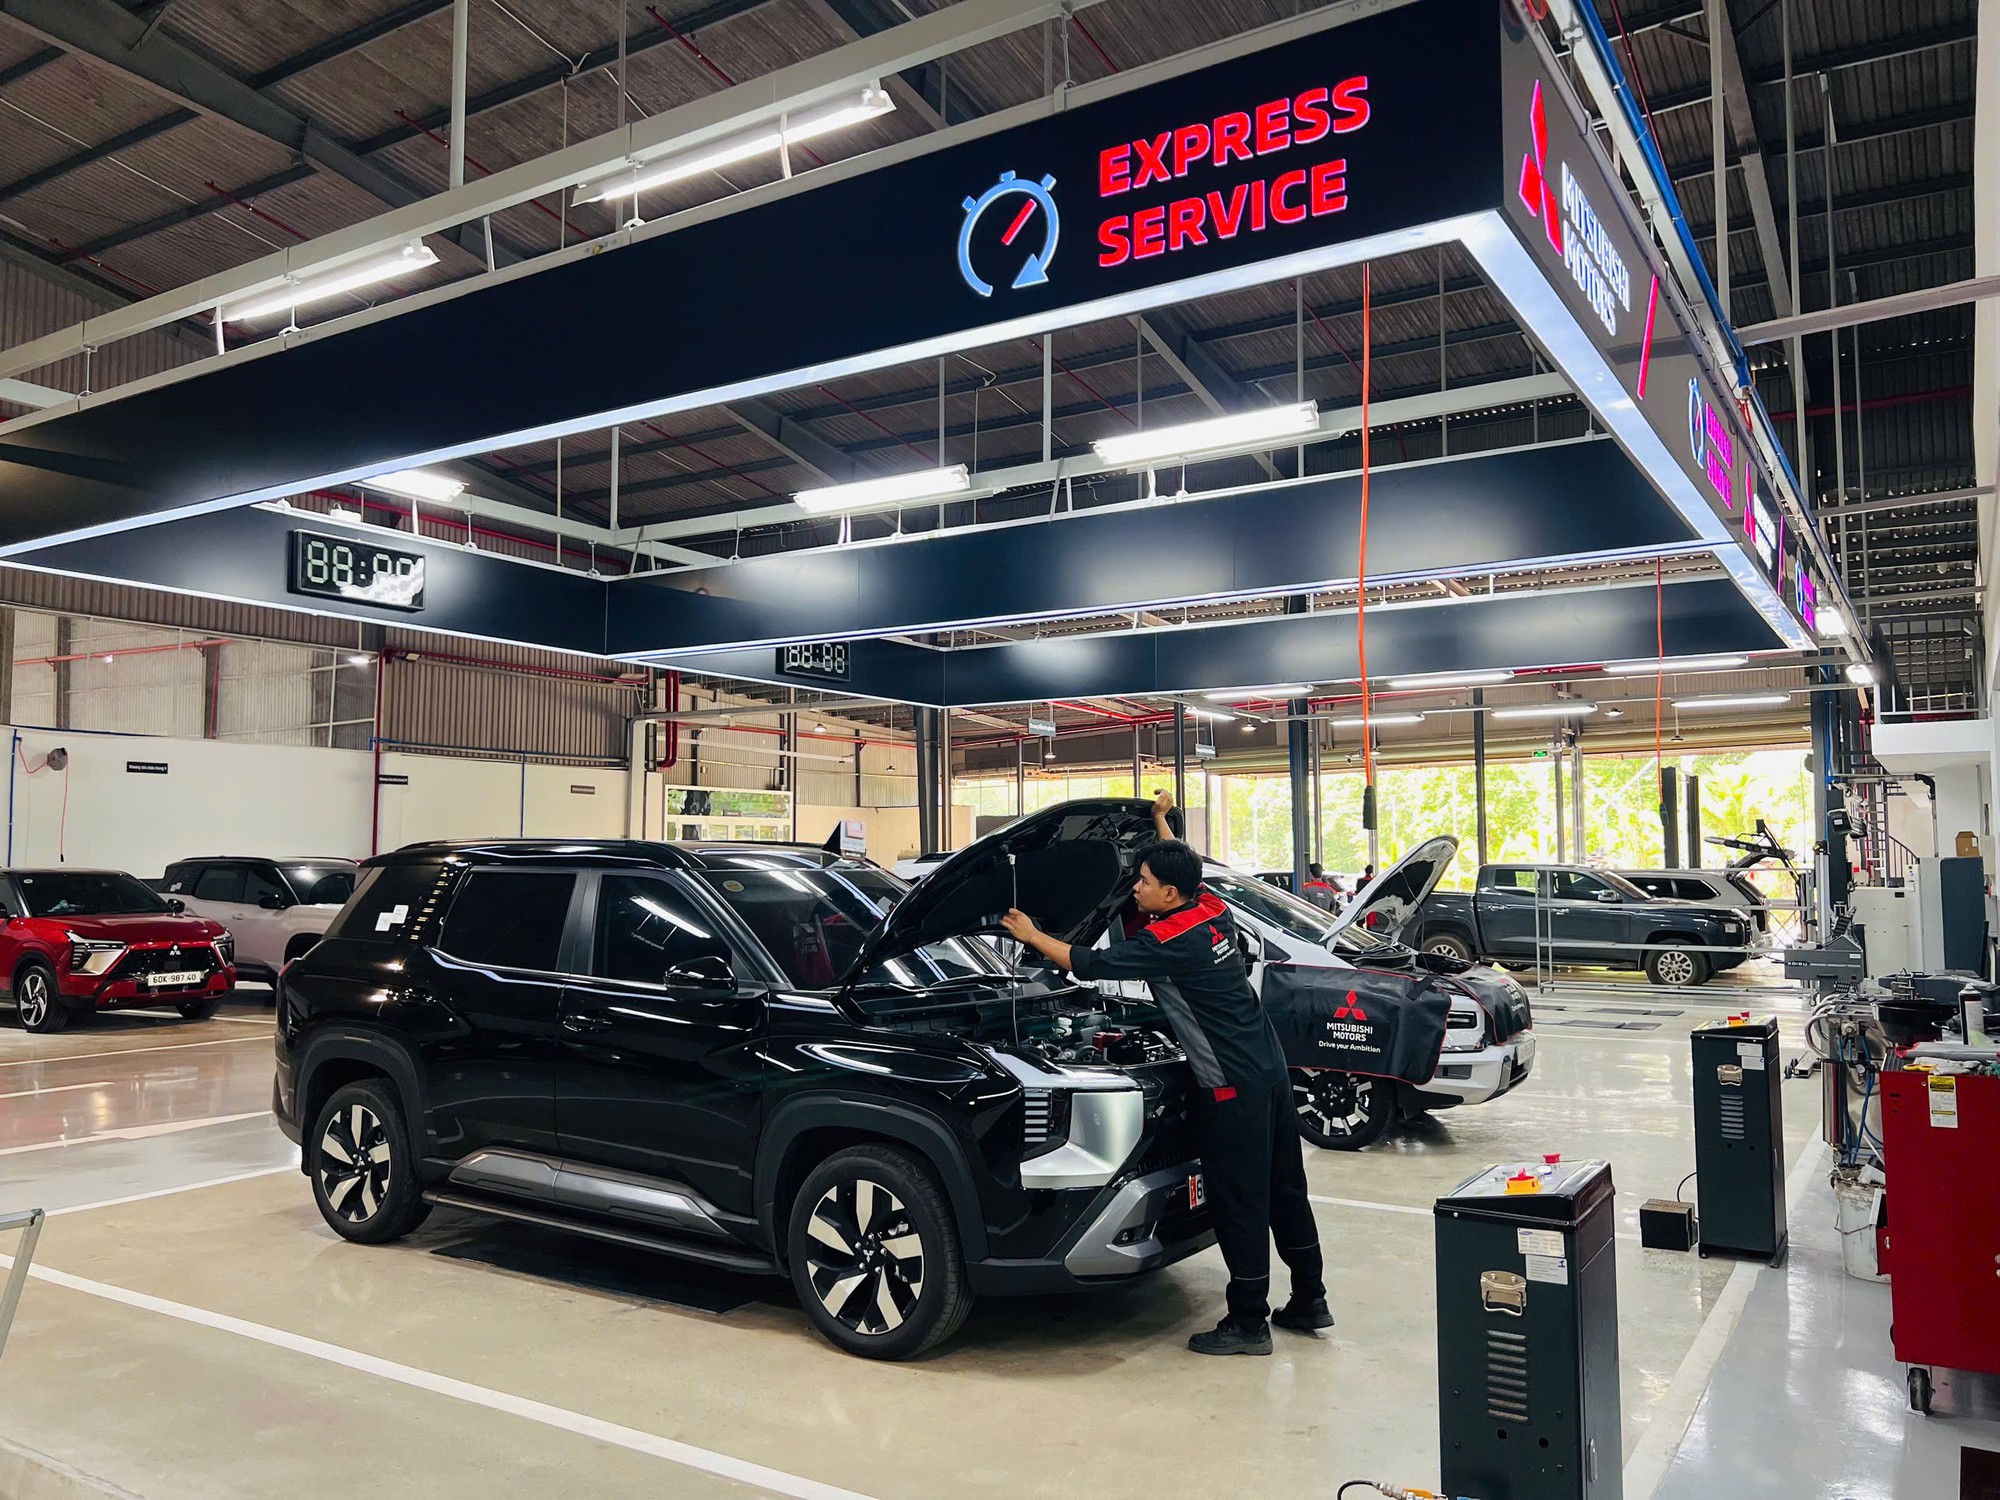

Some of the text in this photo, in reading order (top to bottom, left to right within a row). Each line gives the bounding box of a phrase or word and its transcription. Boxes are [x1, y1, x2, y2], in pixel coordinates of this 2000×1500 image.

[1100, 76, 1370, 197] EXPRESS
[1098, 158, 1348, 268] SERVICE
[1561, 160, 1631, 313] MITSUBISHI
[1563, 218, 1616, 337] MOTORS
[1318, 1040, 1336, 1048] Drive
[1349, 1043, 1381, 1053] Ambition
[1326, 1022, 1373, 1034] MITSUBISHI
[1333, 1031, 1367, 1042] MOTORS
